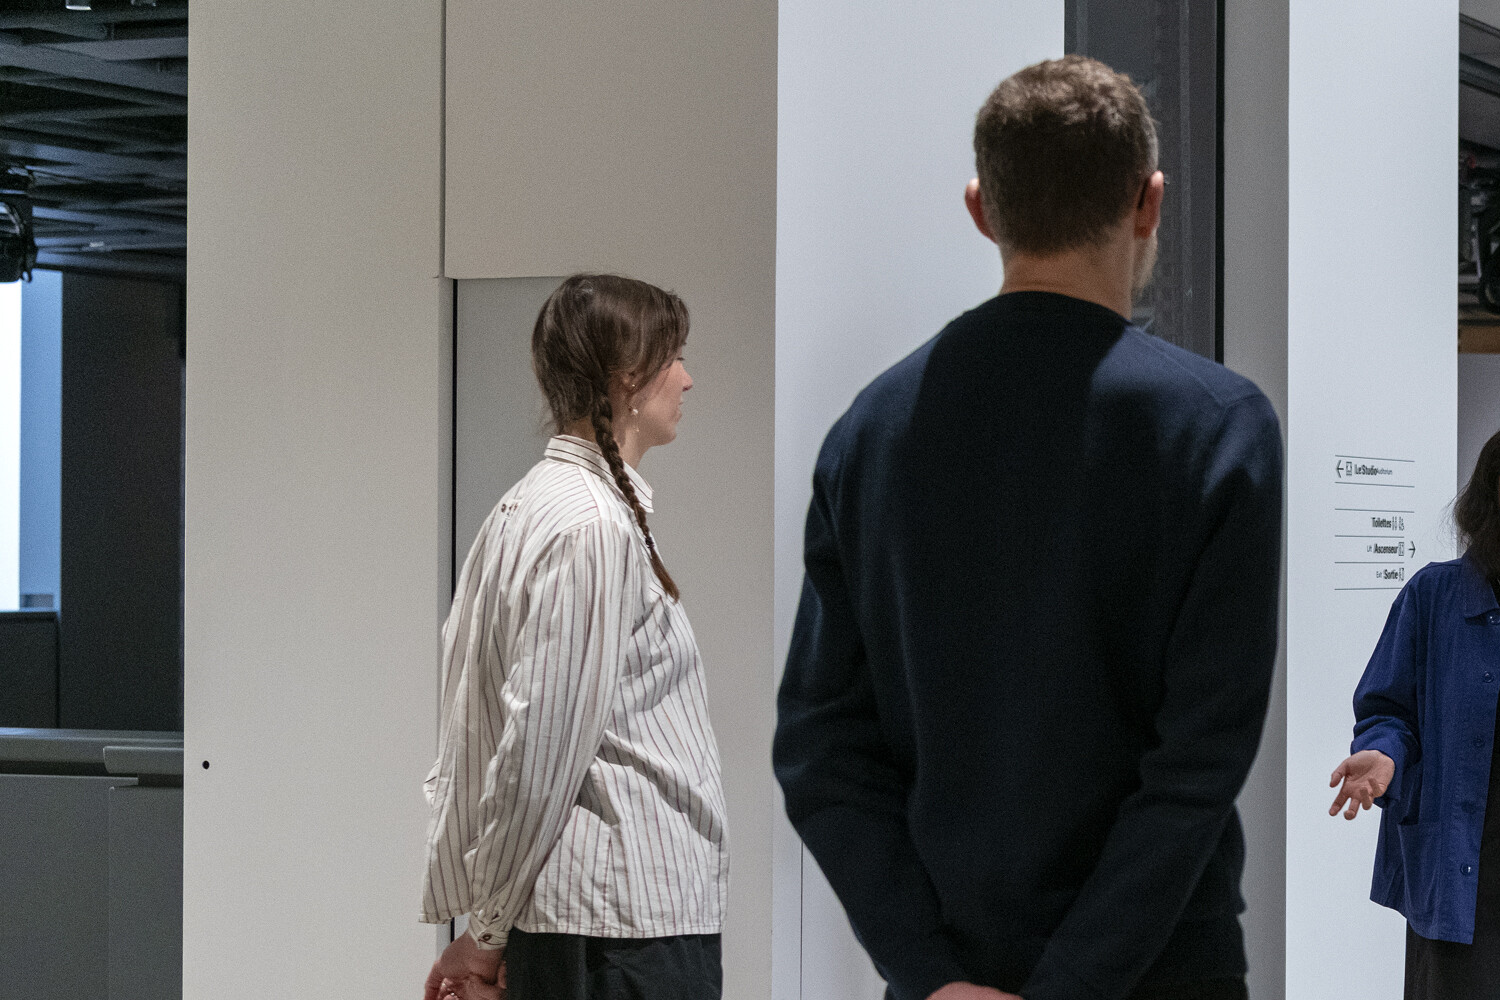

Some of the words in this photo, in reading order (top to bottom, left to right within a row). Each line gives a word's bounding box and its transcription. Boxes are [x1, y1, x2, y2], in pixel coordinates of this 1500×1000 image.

[1355, 464, 1361, 474] Le
[1361, 464, 1377, 476] Studio
[1372, 517, 1391, 528] Toilettes
[1374, 543, 1399, 553] Ascenseur
[1384, 569, 1398, 580] Sortie
